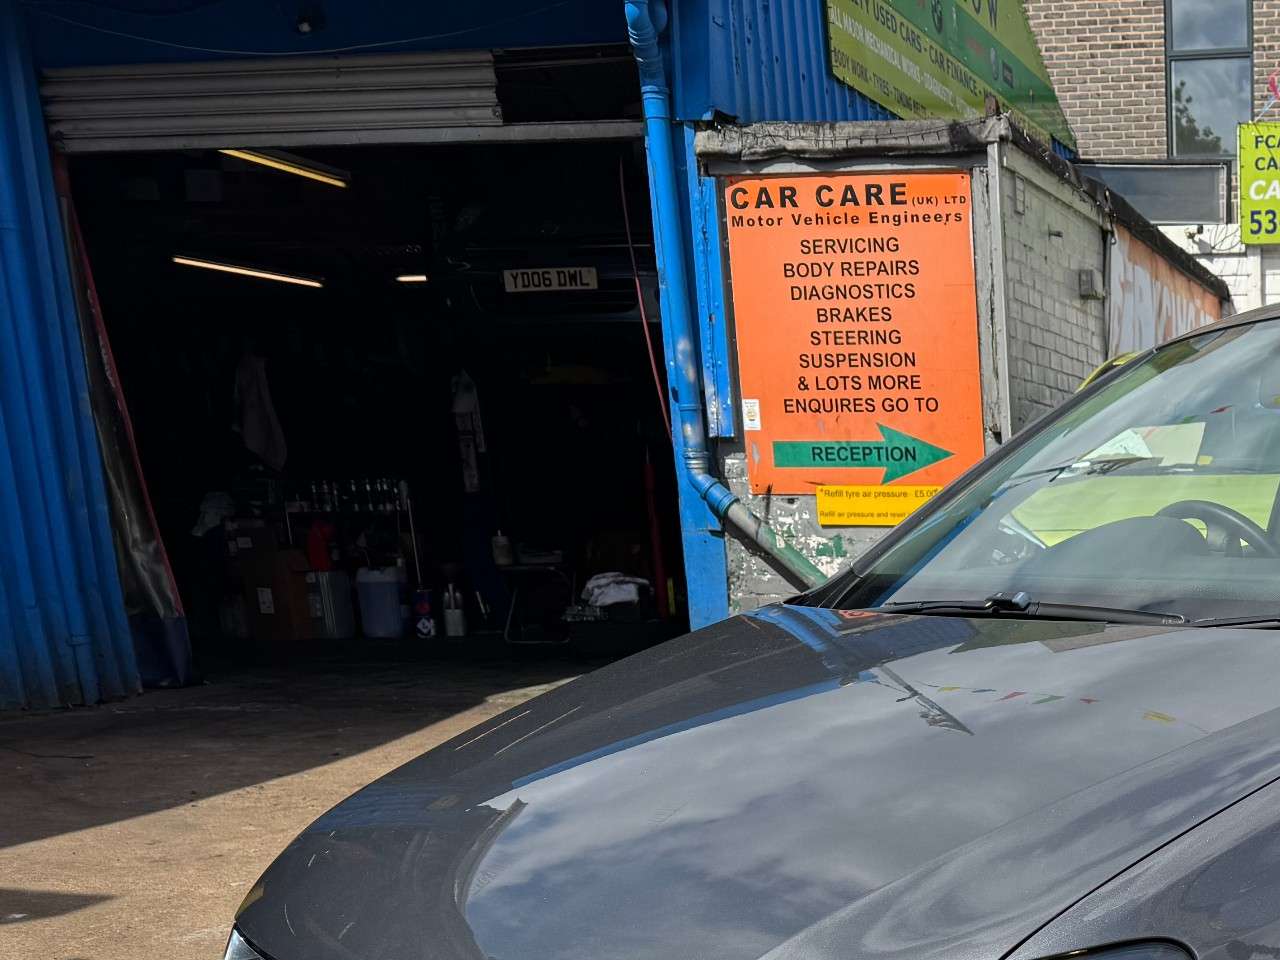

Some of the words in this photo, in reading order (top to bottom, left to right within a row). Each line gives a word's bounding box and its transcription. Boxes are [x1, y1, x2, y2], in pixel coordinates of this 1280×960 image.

[873, 0, 897, 33] USED
[900, 21, 922, 53] CARS
[929, 45, 945, 72] CAR
[946, 57, 978, 97] FINANCE
[730, 186, 799, 210] CAR
[816, 182, 908, 207] CARE
[911, 196, 939, 206] (UK)
[944, 195, 967, 204] LTD
[731, 215, 783, 228] Motor
[791, 212, 860, 226] Vehicle
[869, 210, 963, 226] Engineers
[800, 236, 900, 255] SERVICING
[783, 261, 835, 278] BODY
[840, 260, 920, 277] REPAIRS
[510, 270, 552, 289] YD06
[556, 269, 590, 288] DWL
[790, 283, 916, 301] DIAGNOSTICS
[816, 306, 892, 323] BRAKES
[810, 329, 902, 346] STEERING
[799, 352, 917, 369] SUSPENSION
[797, 376, 810, 391] &
[815, 375, 862, 391] LOTS
[867, 374, 922, 390] MORE
[783, 398, 876, 415] ENQUIRES
[881, 397, 910, 413] GO
[914, 397, 940, 412] TO
[811, 445, 917, 462] RECEPTION
[845, 489, 859, 499] tyre
[873, 490, 908, 499] pressure
